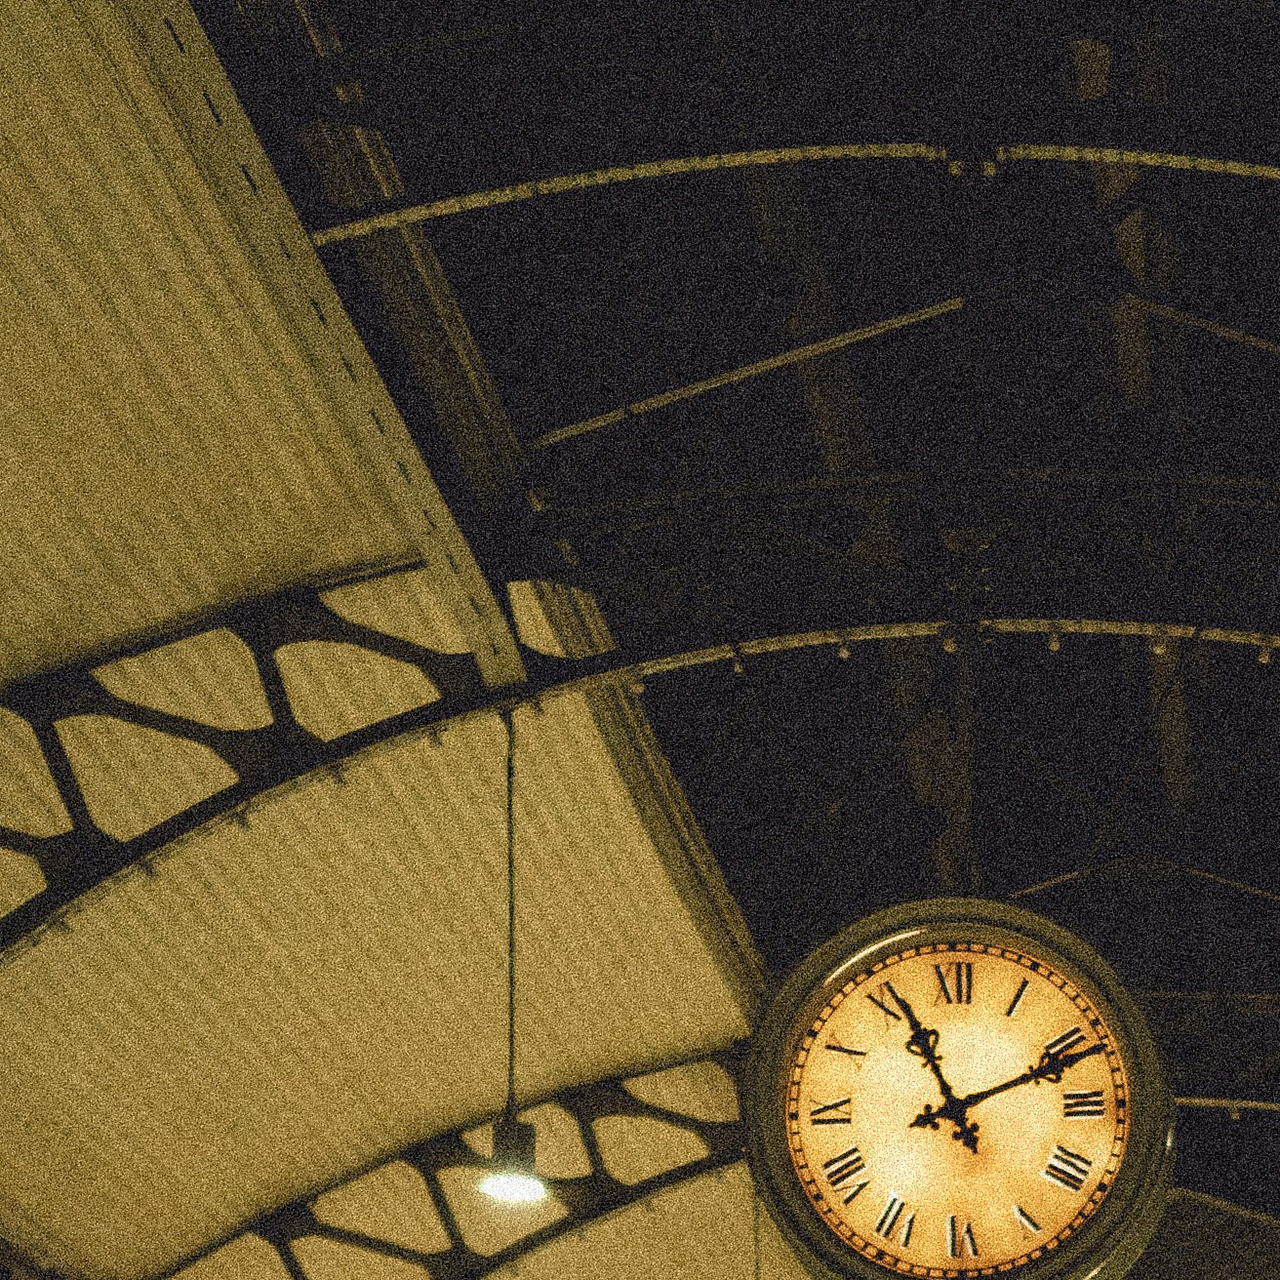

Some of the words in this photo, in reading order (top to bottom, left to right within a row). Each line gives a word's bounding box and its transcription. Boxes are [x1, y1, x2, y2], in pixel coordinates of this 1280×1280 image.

[933, 961, 973, 1005] XII
[1006, 977, 1030, 1017] I
[1045, 1026, 1086, 1058] II
[809, 1098, 851, 1126] IX
[1063, 1090, 1106, 1118] III
[823, 1146, 871, 1205] VIII
[1045, 1144, 1093, 1192] IIII
[875, 1197, 917, 1248] VII
